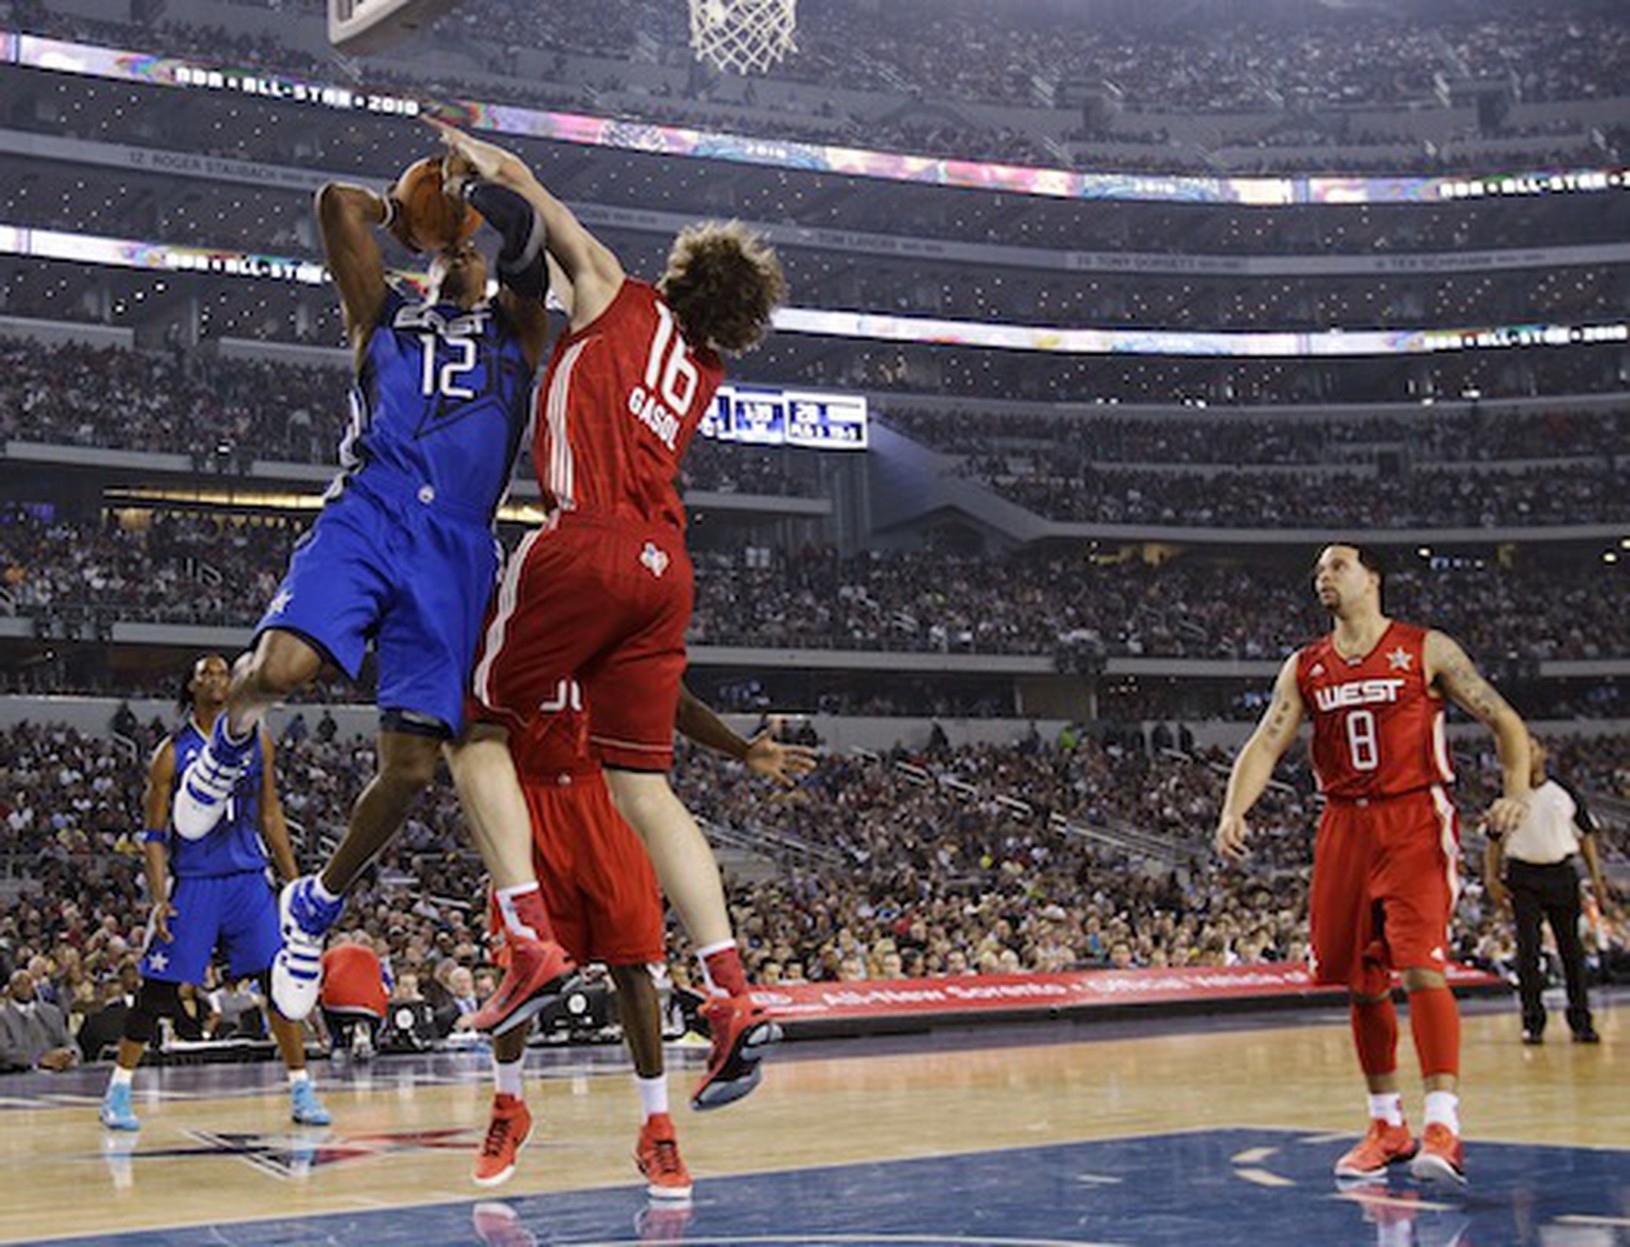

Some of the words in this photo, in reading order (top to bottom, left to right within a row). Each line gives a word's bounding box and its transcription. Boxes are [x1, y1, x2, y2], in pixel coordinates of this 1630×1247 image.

[367, 95, 419, 115] 2010
[152, 153, 201, 170] ROGER
[418, 333, 476, 400] 12
[645, 300, 698, 416] 16
[628, 386, 681, 451] GASOL
[1315, 679, 1406, 712] WEST
[1346, 710, 1379, 771] 8
